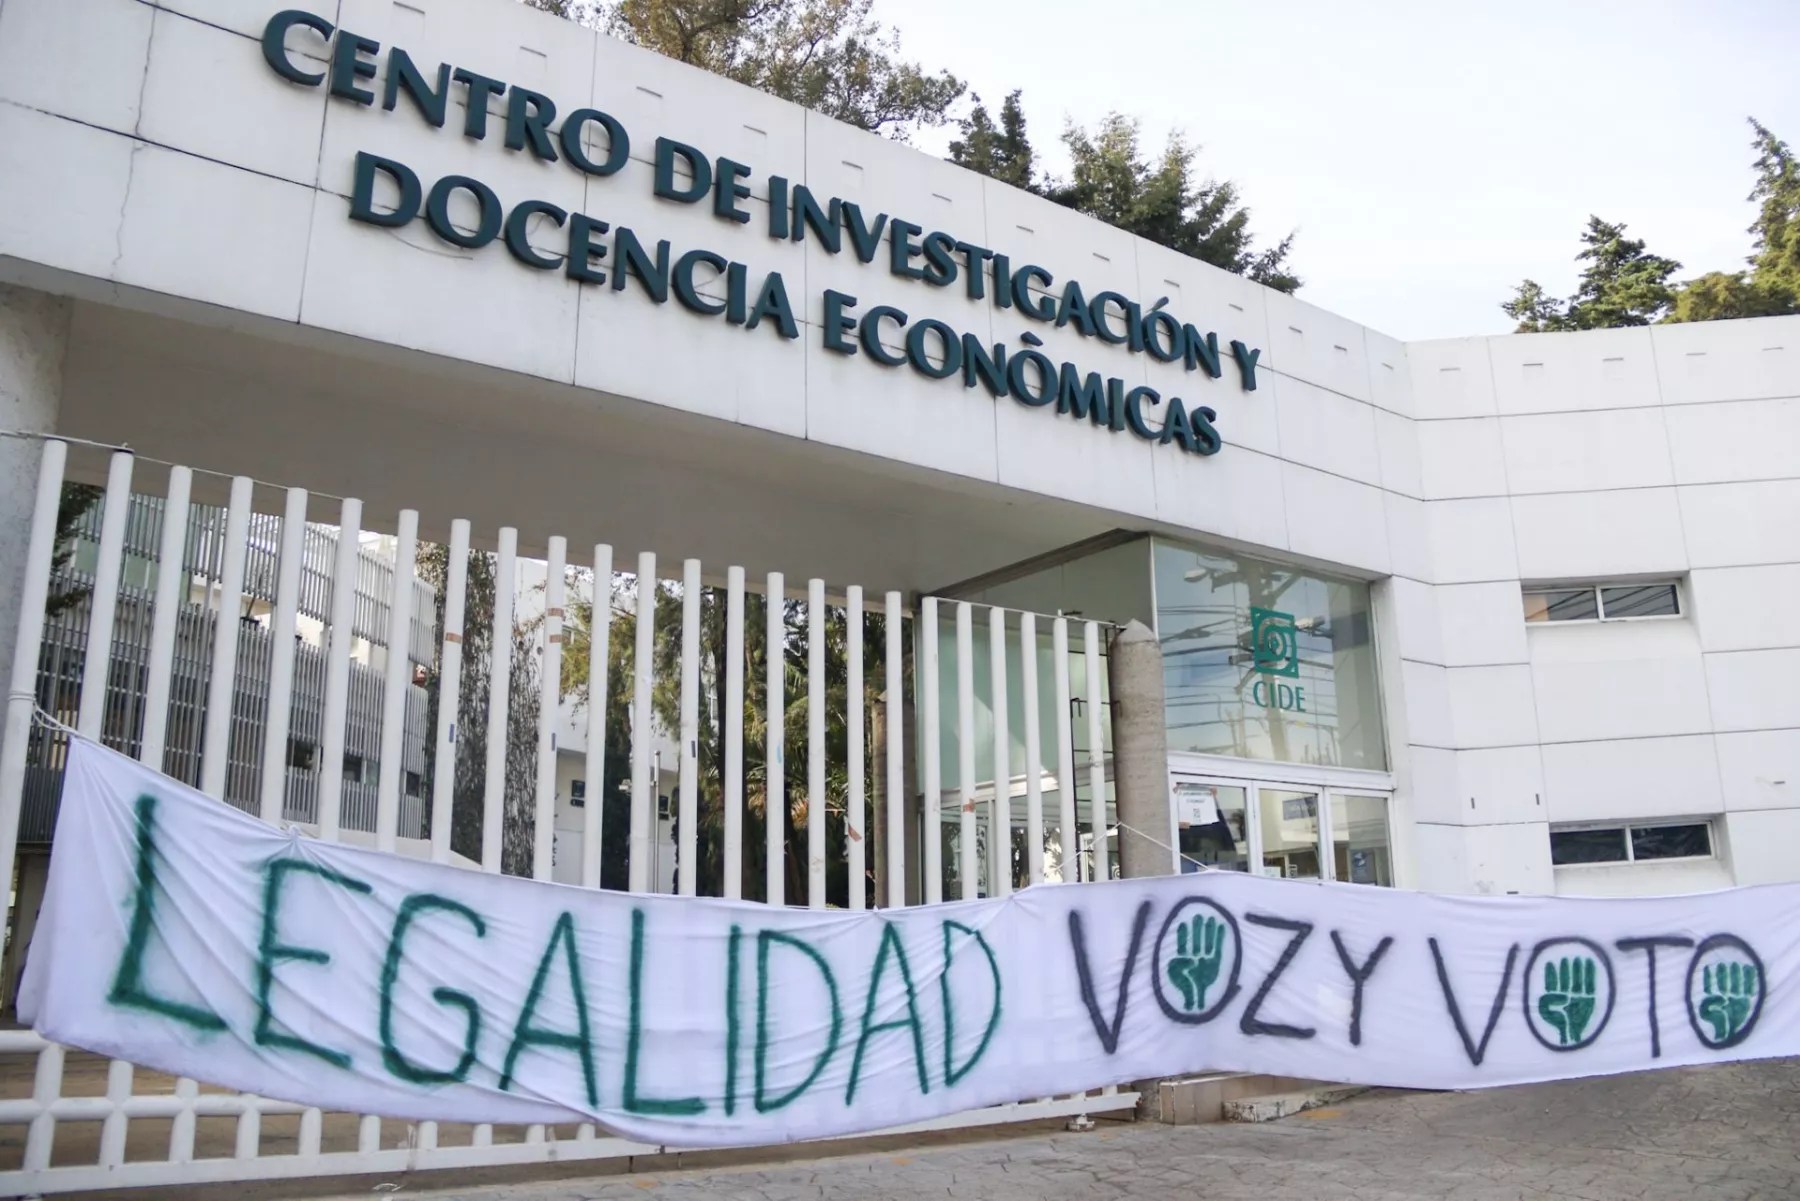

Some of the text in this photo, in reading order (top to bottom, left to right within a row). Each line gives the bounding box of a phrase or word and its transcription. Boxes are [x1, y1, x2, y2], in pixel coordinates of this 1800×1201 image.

[262, 10, 1260, 392] CENTRO DE INVESTIGACIÓN Y
[348, 151, 799, 339] DOCENCIA
[1253, 681, 1306, 712] CIDE
[106, 794, 1767, 1116] LEGALIDAD VOZ Y VOTO
